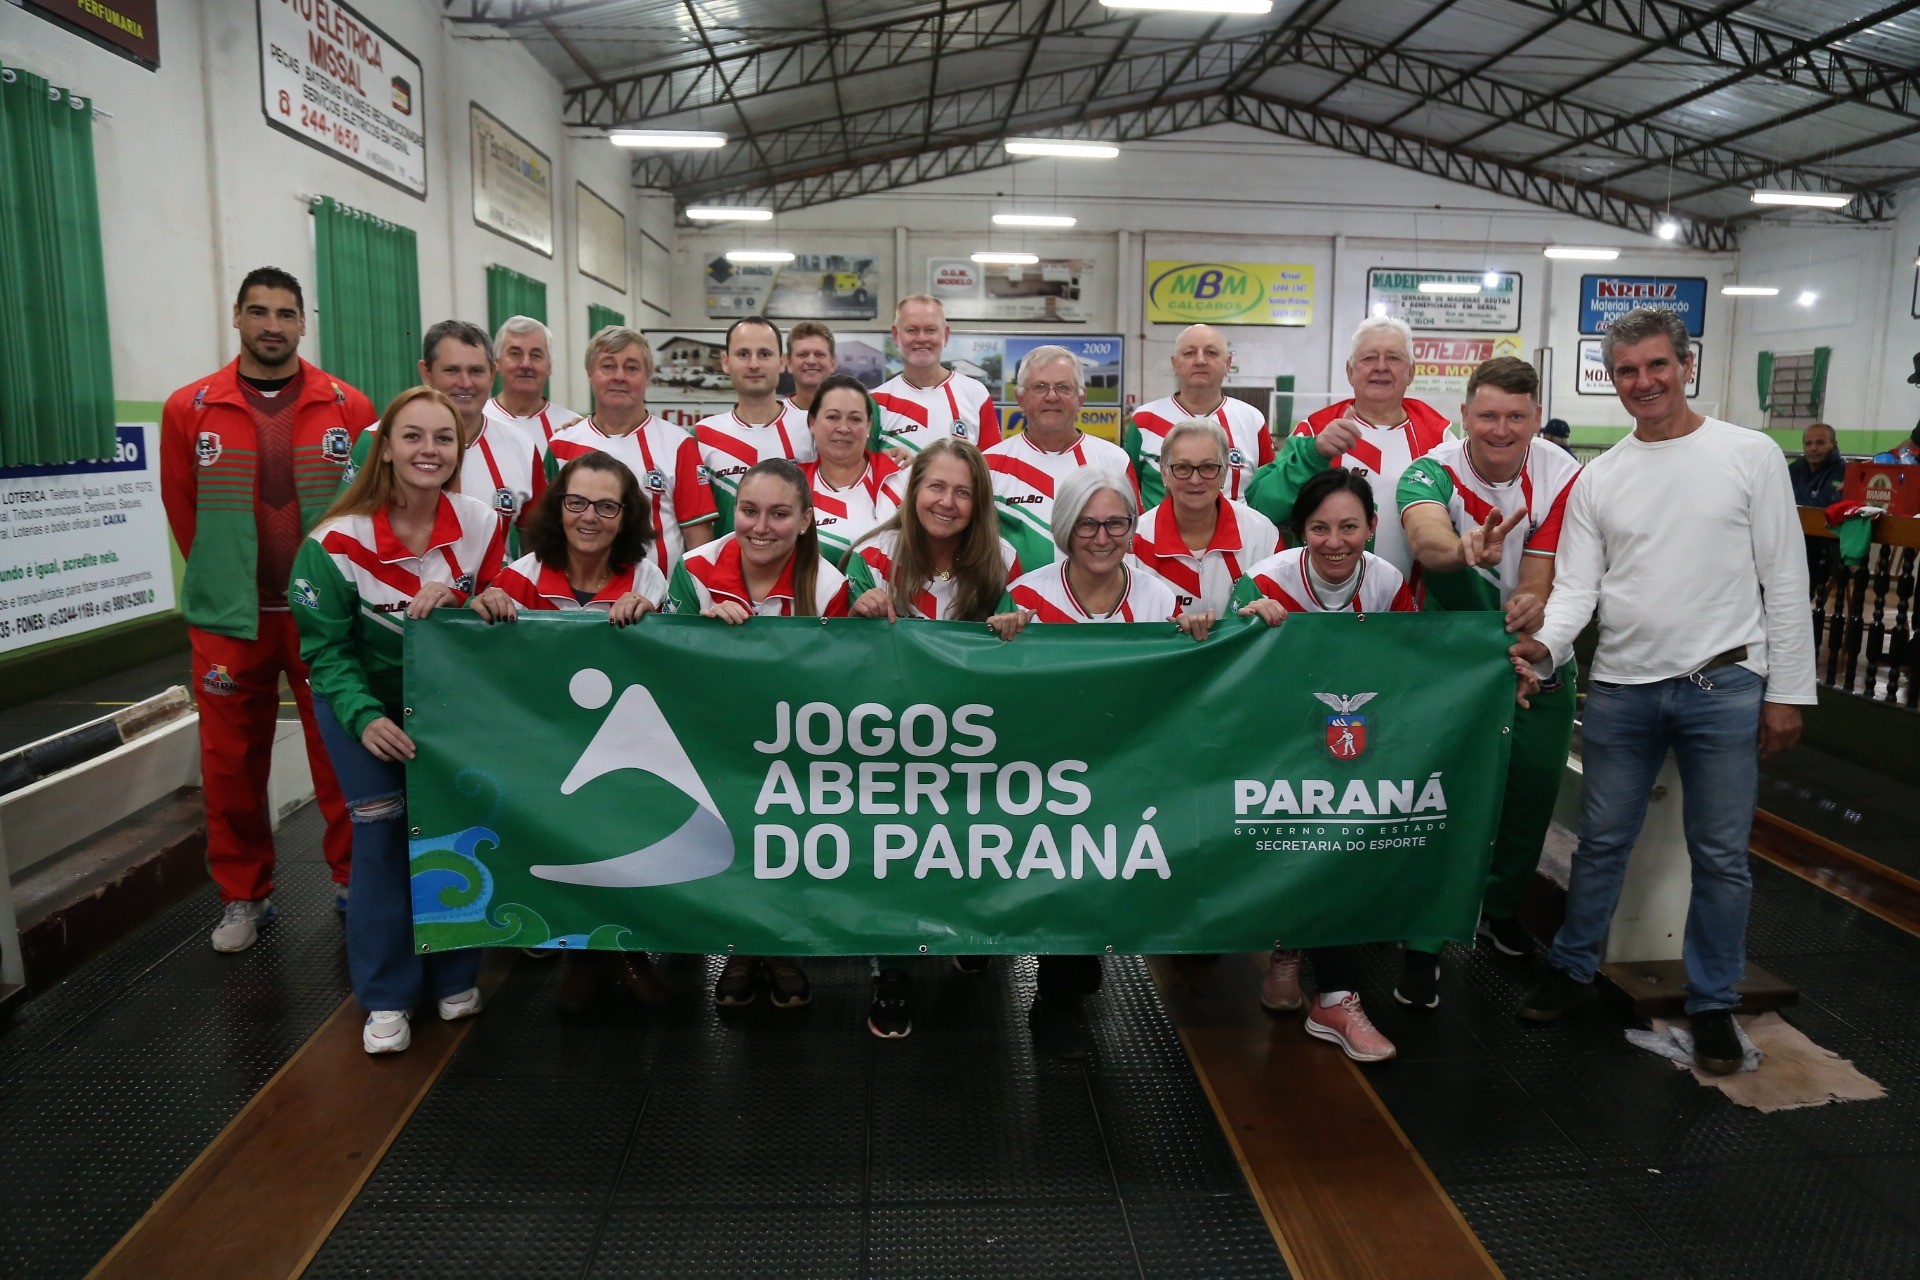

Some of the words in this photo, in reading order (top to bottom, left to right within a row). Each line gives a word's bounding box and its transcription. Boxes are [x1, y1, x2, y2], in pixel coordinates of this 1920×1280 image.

[77, 0, 144, 40] PERFUMARIA
[308, 29, 367, 98] MISSAL
[301, 104, 360, 154] 244-1650
[937, 278, 973, 286] MODELO
[1170, 270, 1248, 298] MBM
[1596, 279, 1676, 300] KREUZ
[1590, 298, 1630, 312] Materiais
[972, 341, 998, 352] 1994
[1083, 343, 1110, 354] 2000
[1412, 341, 1495, 361] ontana
[1082, 412, 1117, 424] SONY
[12, 525, 43, 538] Loterias
[103, 514, 127, 526] CAIXA
[0, 564, 24, 582] undo
[35, 558, 61, 580] igual,
[63, 553, 98, 572] acredite
[754, 700, 996, 756] JOGOS
[754, 760, 1092, 816] ABERTOS
[1234, 772, 1448, 814] PARANÁ
[1234, 827, 1325, 836] GOVERNO
[1342, 828, 1364, 836] DO
[1380, 822, 1446, 834] ESTADO
[754, 823, 850, 880] DO
[874, 806, 1172, 880] PARANÁ
[1256, 840, 1342, 850] SECRETARIA
[1346, 841, 1366, 850] DO
[1369, 836, 1426, 850] ESPORTE
